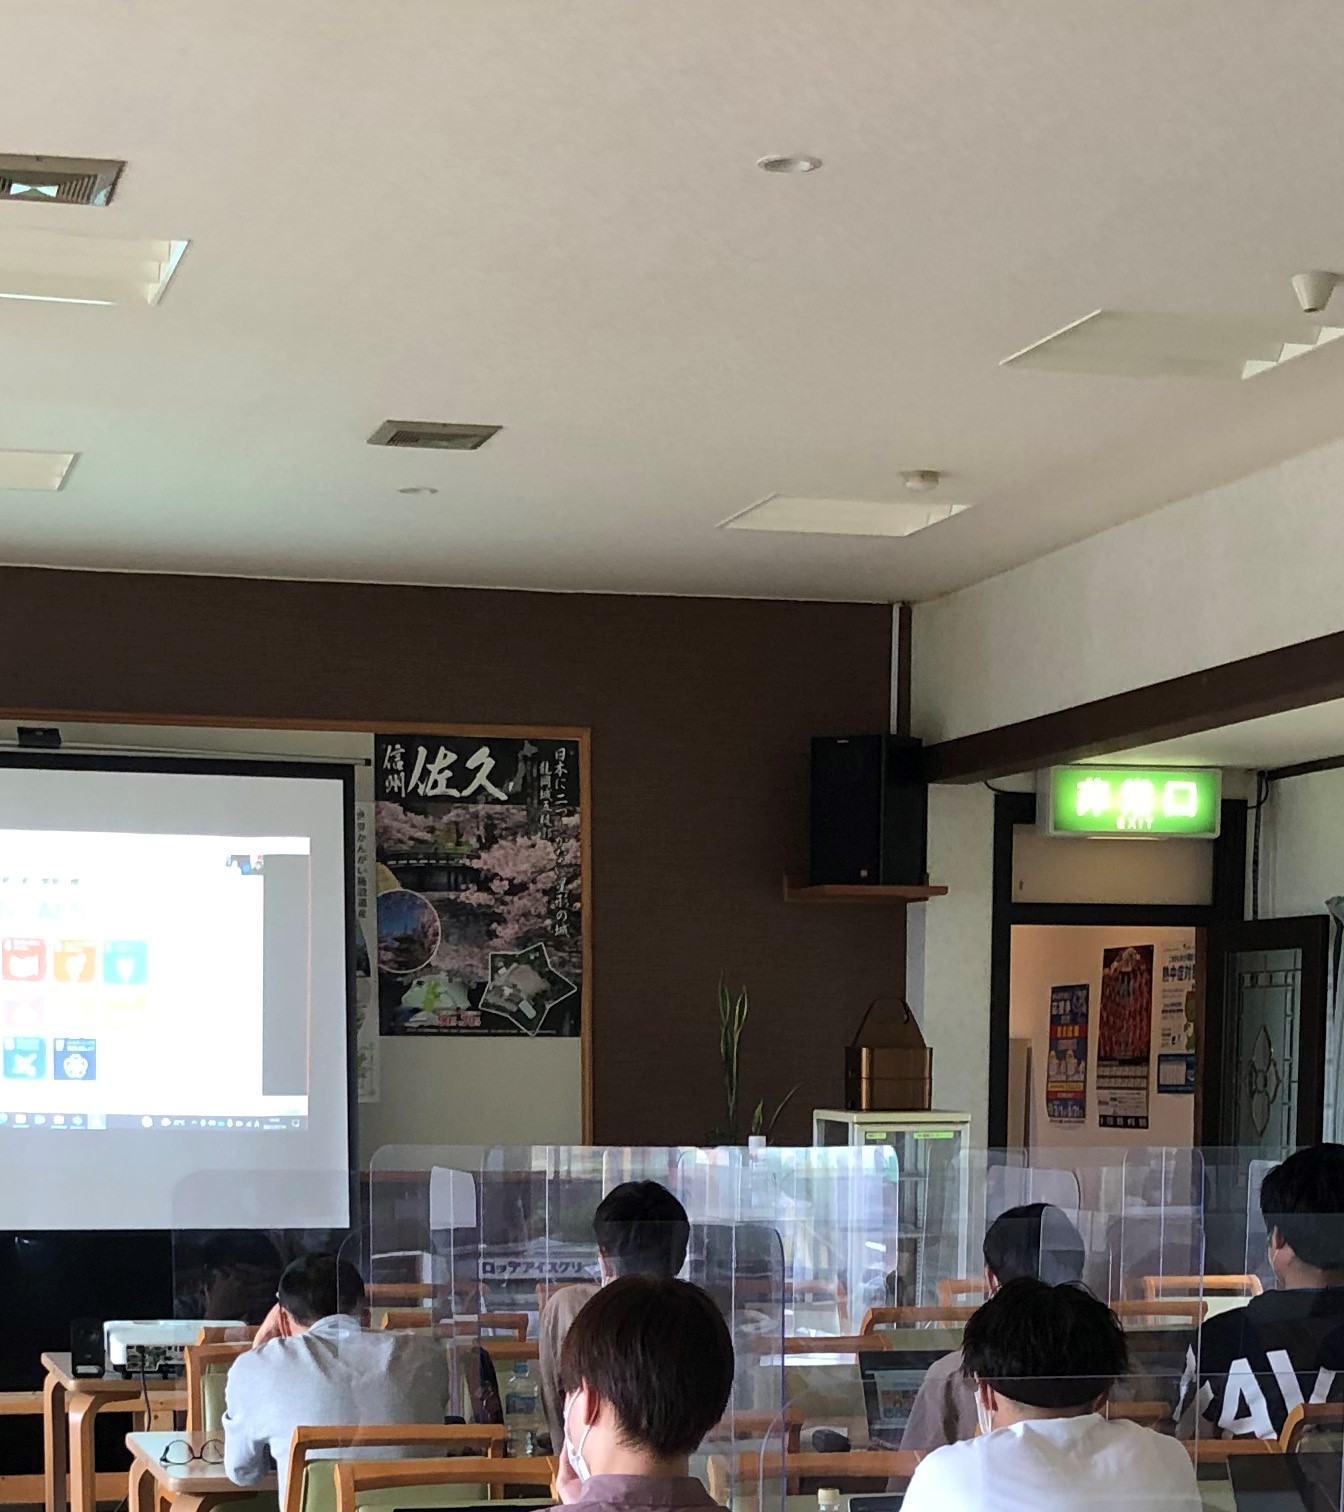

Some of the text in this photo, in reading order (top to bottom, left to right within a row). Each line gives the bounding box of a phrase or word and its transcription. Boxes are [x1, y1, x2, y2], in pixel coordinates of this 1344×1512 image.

[382, 743, 406, 799] 信州
[407, 745, 508, 801] 佐久
[1075, 777, 1198, 818] 非常口
[1116, 816, 1155, 830] EXIT
